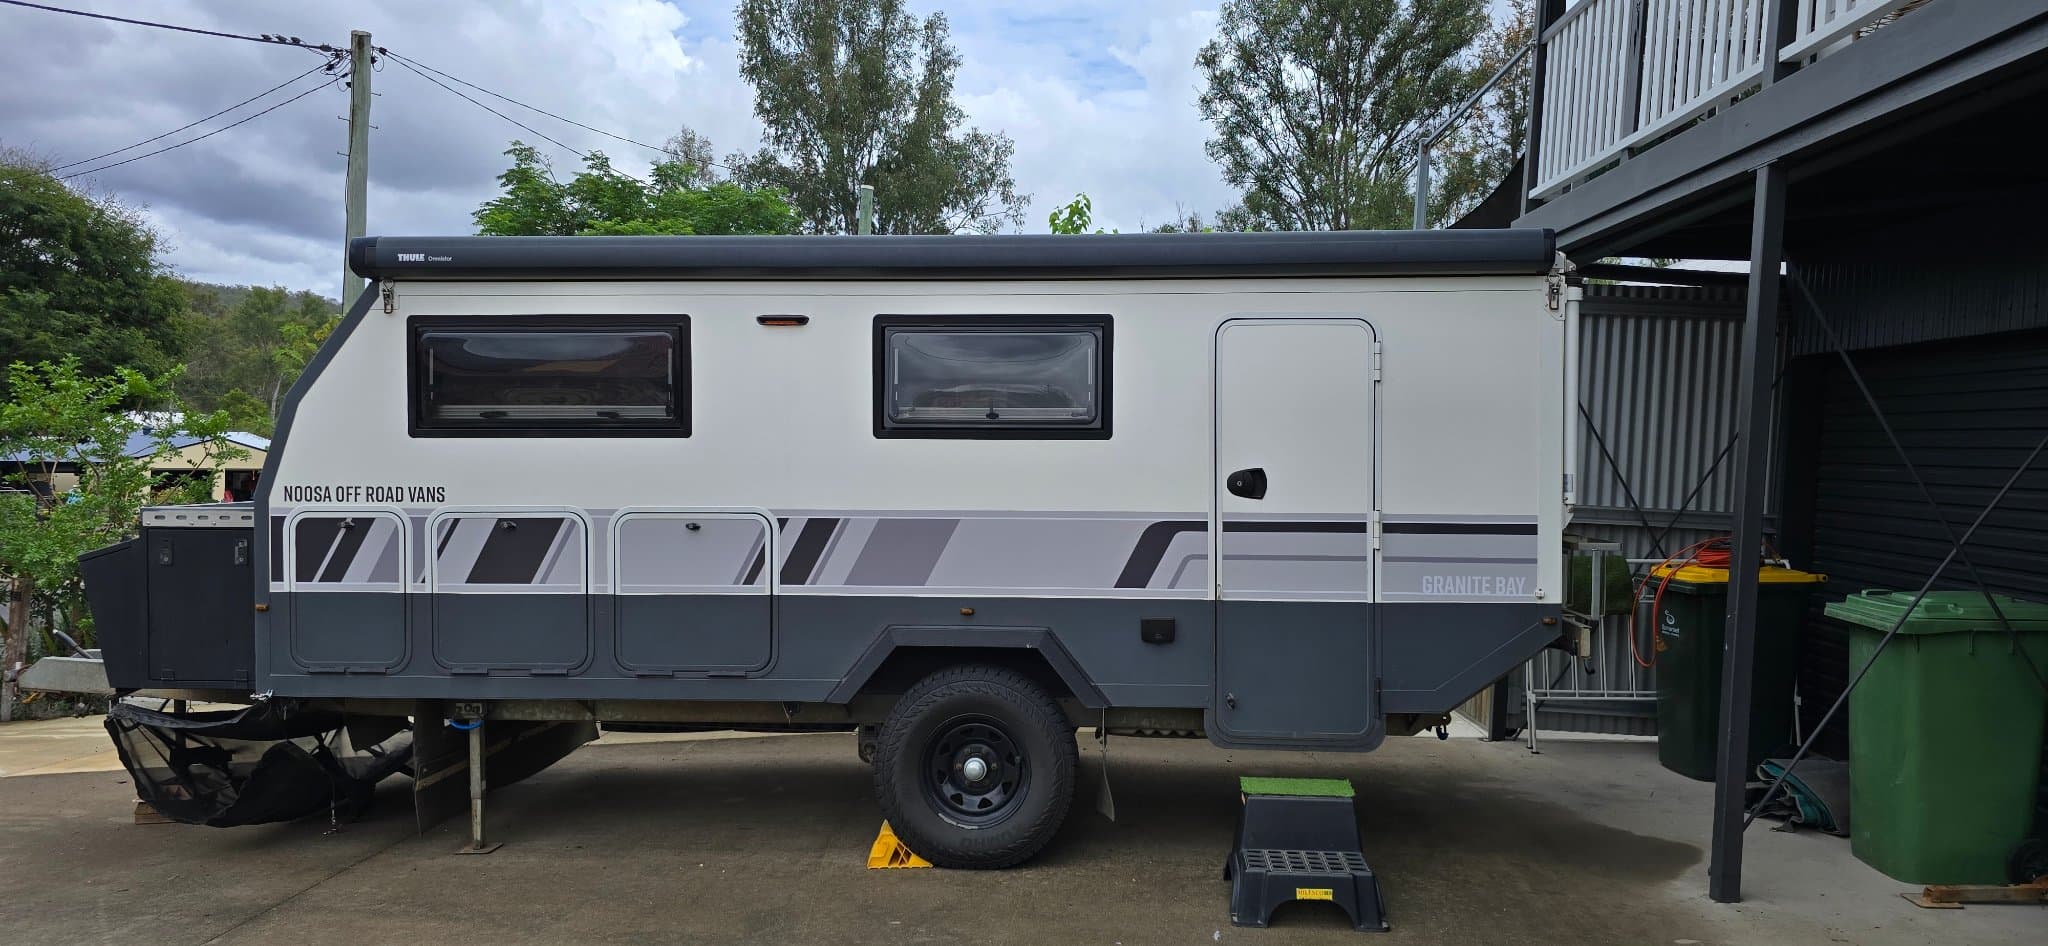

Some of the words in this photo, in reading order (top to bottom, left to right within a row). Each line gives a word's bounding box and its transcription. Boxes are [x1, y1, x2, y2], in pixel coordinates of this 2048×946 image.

[398, 253, 425, 262] THULE
[284, 485, 332, 502] NOOSA
[335, 486, 361, 502] OFF
[366, 486, 404, 502] ROAD
[408, 486, 446, 503] VANS
[1422, 575, 1491, 594] GRANITE
[1495, 576, 1527, 595] BAY
